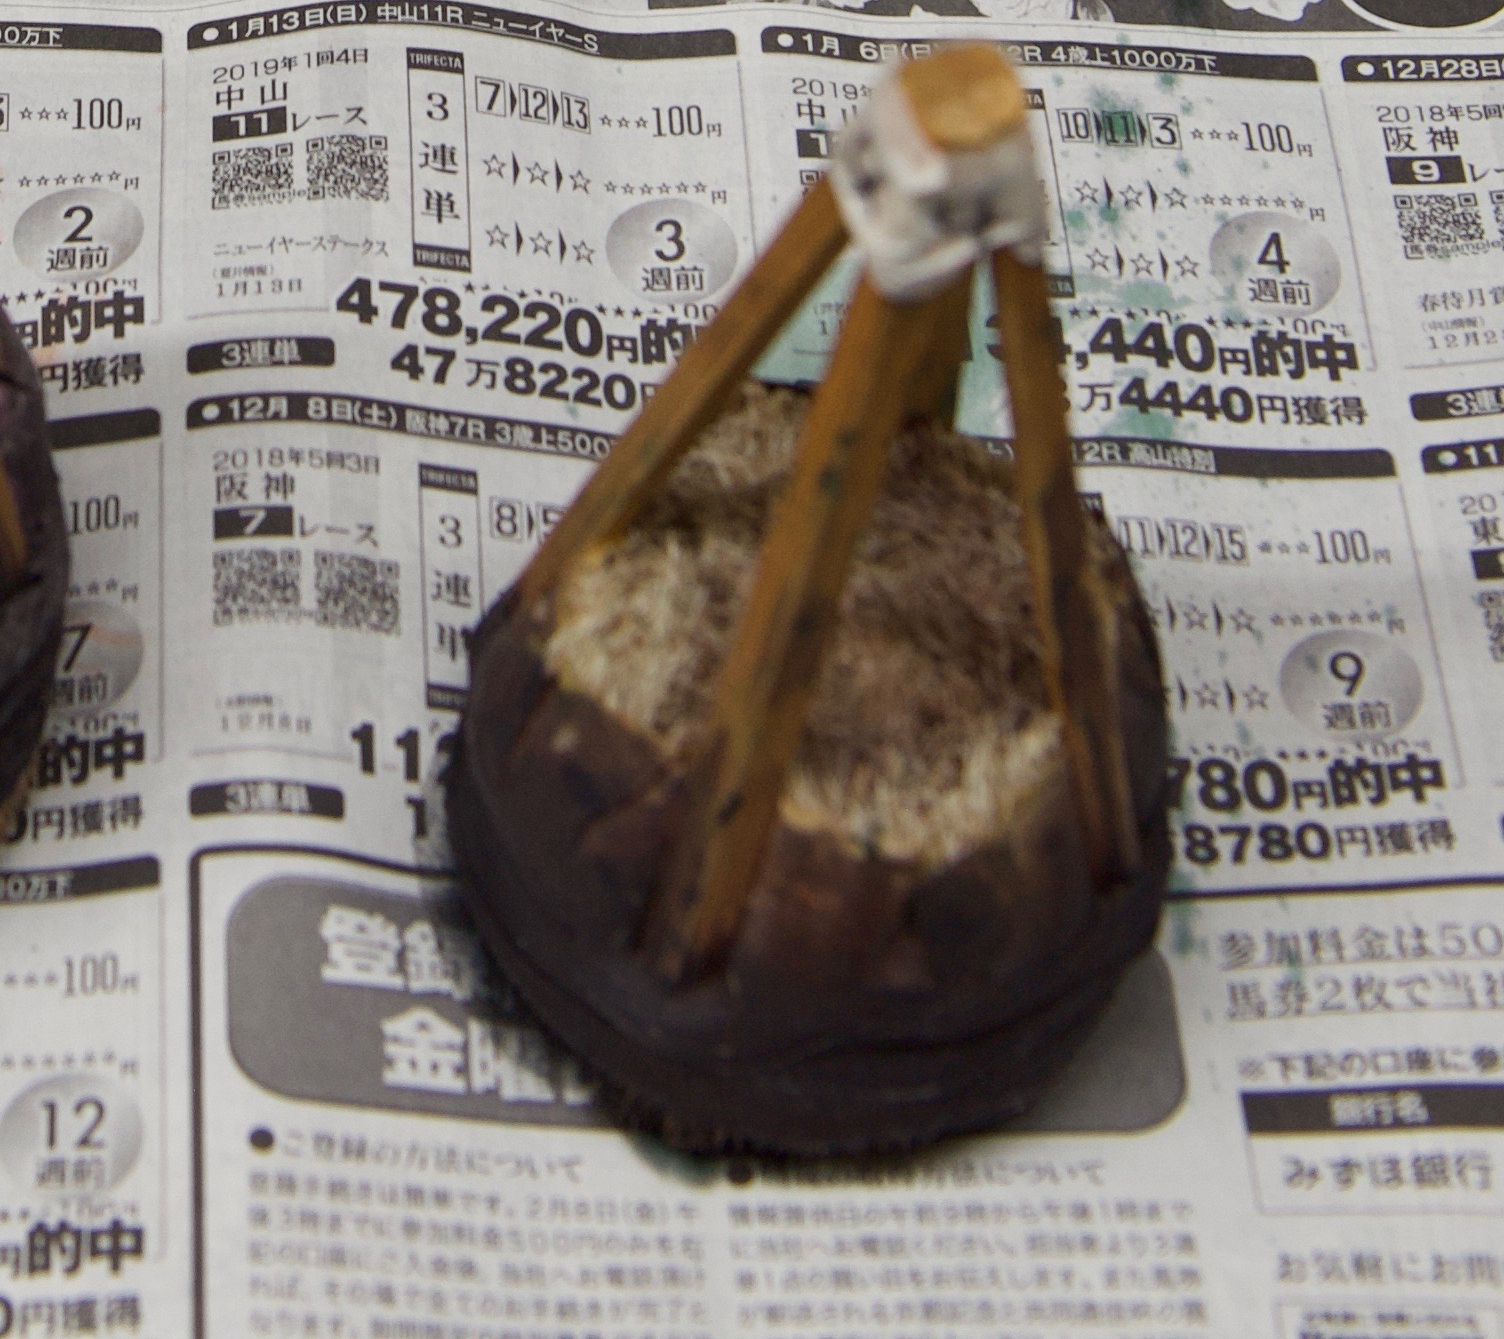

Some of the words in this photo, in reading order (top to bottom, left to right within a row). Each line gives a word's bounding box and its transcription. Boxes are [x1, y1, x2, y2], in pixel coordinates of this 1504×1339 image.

[225, 6, 368, 43] 1月13日(日)
[376, 2, 464, 29] 中山11R
[469, 11, 601, 55] ニューイヤーS
[408, 48, 465, 73] TRIFECTA
[1049, 44, 1218, 75] 4歳上1000万下
[213, 79, 290, 110] 中山
[291, 103, 368, 133] レース
[1381, 125, 1461, 153] 阪神
[61, 203, 96, 244] 2
[654, 220, 686, 263] 3
[1257, 231, 1292, 274] 4
[44, 246, 109, 273] 週前
[641, 267, 706, 293] 週前
[1247, 277, 1312, 306] 週前
[215, 472, 296, 502] 阪神
[1329, 650, 1365, 699] 9
[38, 1097, 107, 1152] 12
[1281, 1153, 1493, 1194] みずほ銀行
